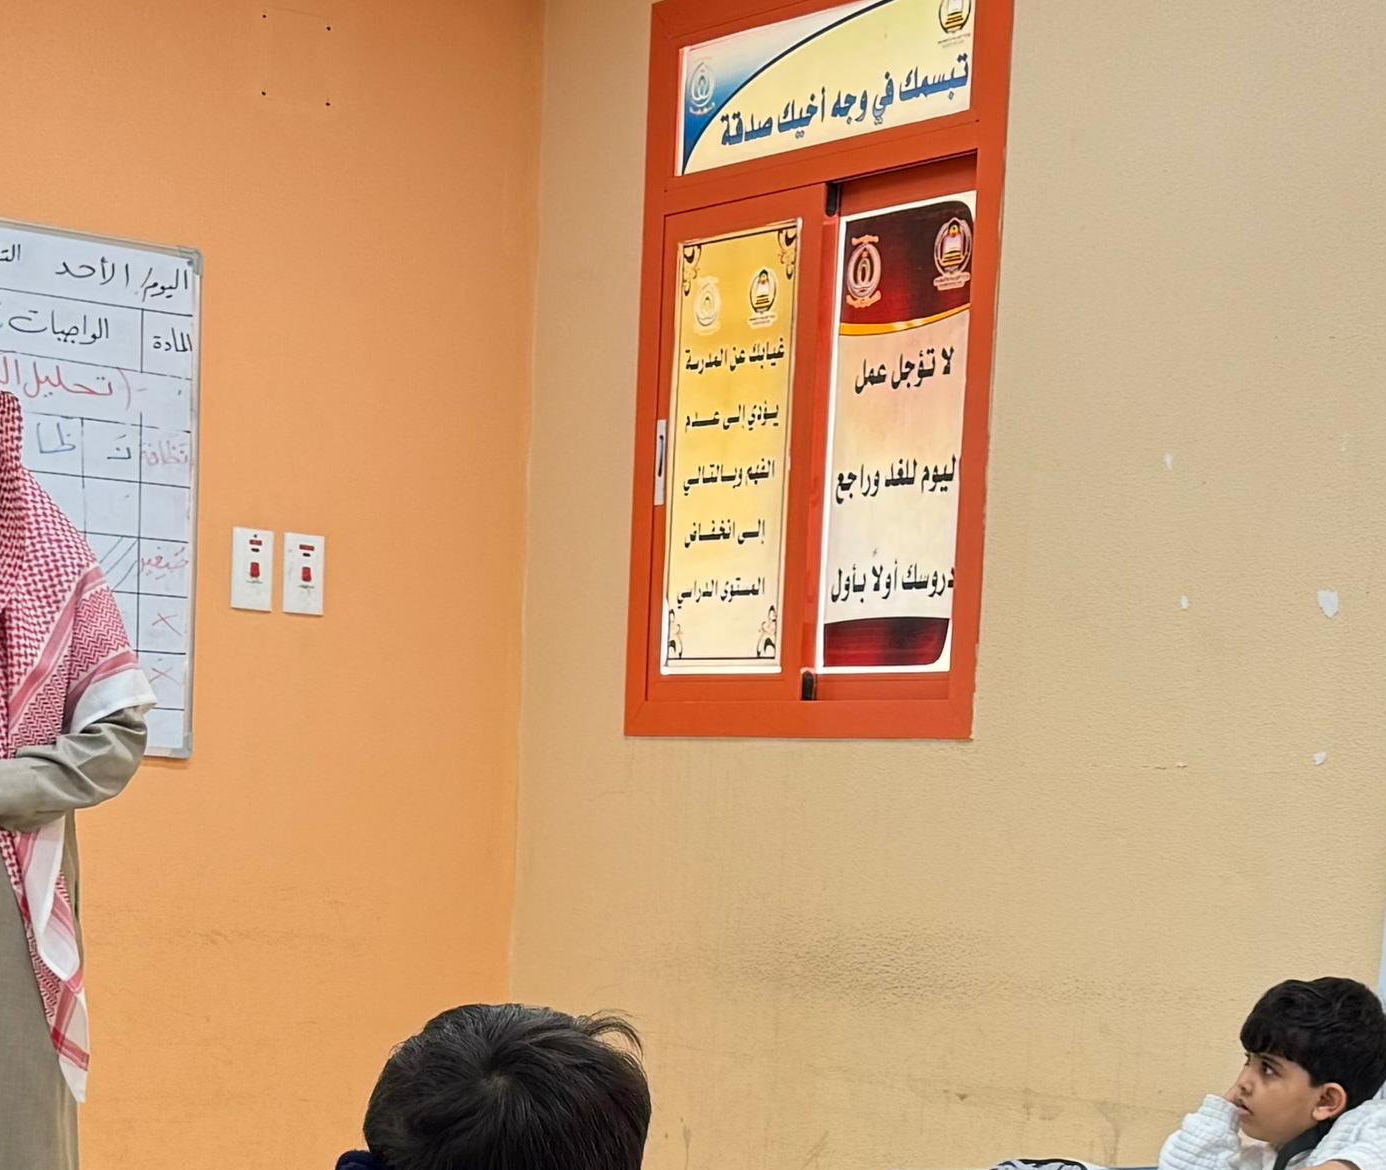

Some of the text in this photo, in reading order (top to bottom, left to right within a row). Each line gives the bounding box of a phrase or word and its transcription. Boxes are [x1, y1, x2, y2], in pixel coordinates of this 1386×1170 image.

[720, 52, 969, 146] تبسمك في وجه أخيك صدقة
[8, 310, 109, 346] الواجبات
[685, 338, 784, 374] غيابك عن المدرسة
[854, 345, 955, 395] لا تؤجل عمل
[685, 411, 720, 433] عدم
[748, 400, 779, 431] يؤدي
[683, 458, 775, 496] الفهم وبالتالي
[835, 463, 880, 504] وراجع
[884, 457, 917, 487] للغد
[684, 519, 736, 548] انخفاض
[676, 578, 719, 609] الدراسي
[831, 563, 866, 603] بأول
